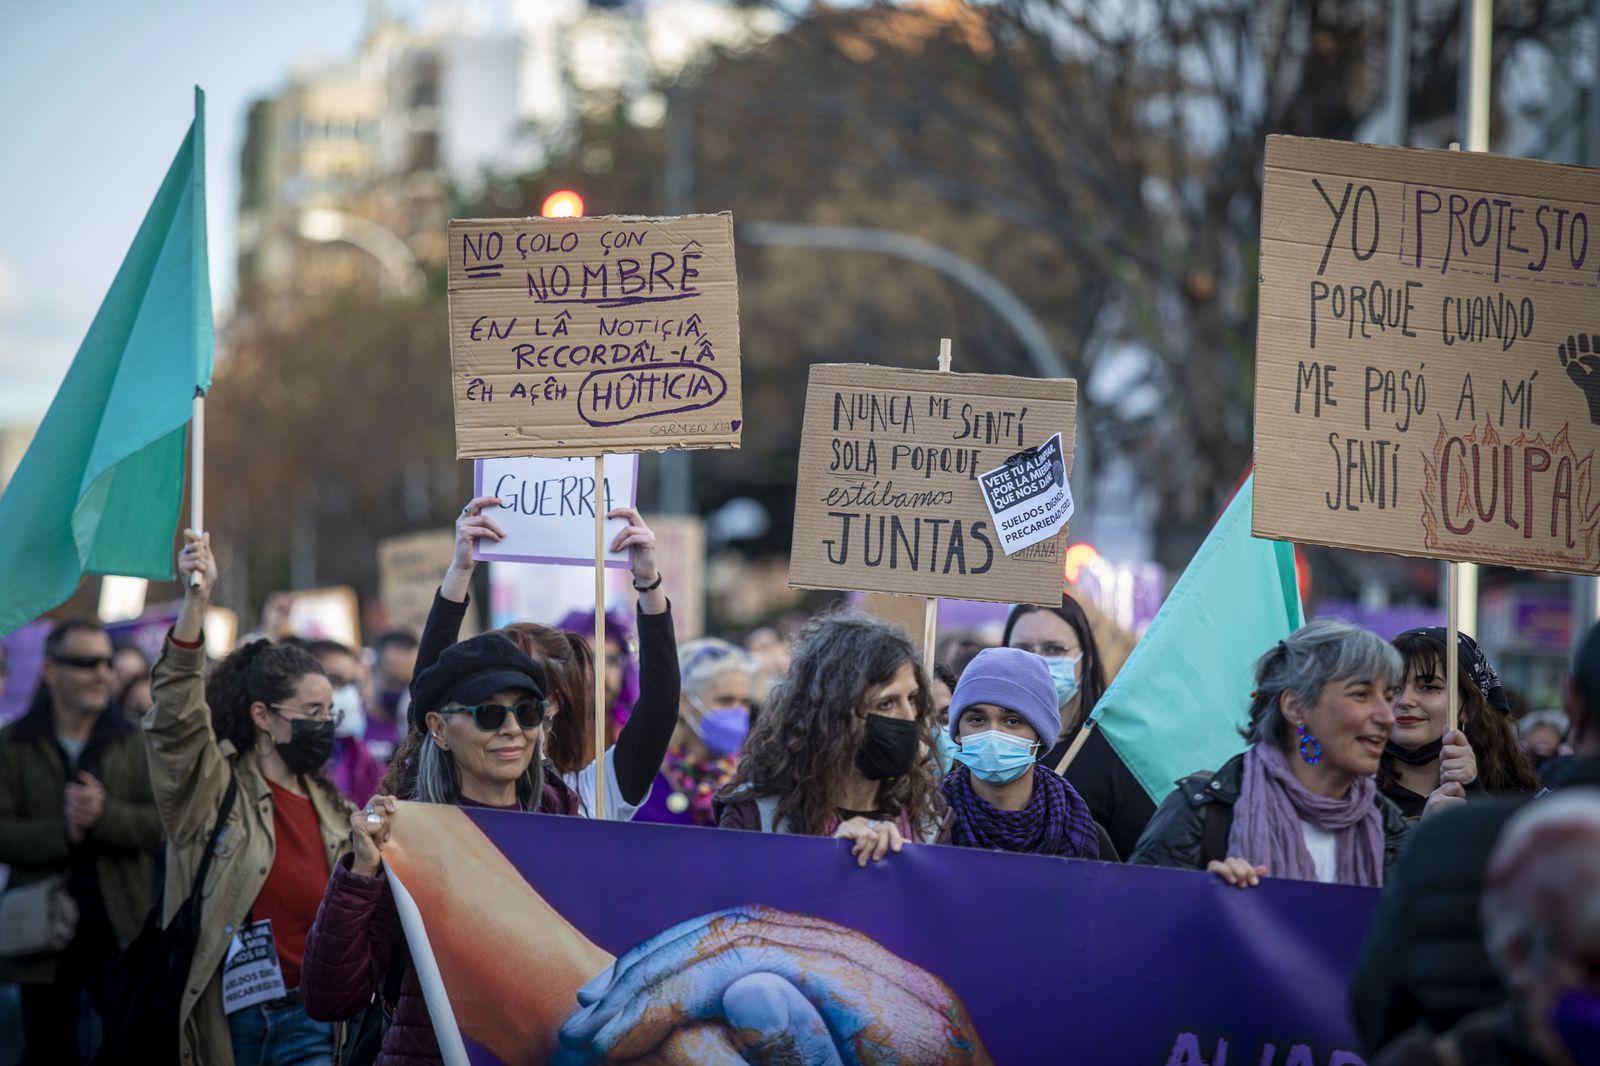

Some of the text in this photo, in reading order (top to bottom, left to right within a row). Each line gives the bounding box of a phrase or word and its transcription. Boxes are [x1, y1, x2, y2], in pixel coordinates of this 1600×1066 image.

[463, 230, 648, 266] NO ÇOLO ÇON
[1312, 178, 1589, 283] YO PROTESTO
[527, 240, 702, 300] NOMBRÊ
[470, 315, 517, 341] EN
[535, 309, 572, 338] LÂ
[1310, 280, 1535, 352] PORQUE CUANDO
[466, 377, 493, 402] ÊH
[1294, 361, 1539, 432] ME PASÓ A MÍ
[833, 393, 1028, 446] NUNCA ME SENTÍ
[830, 438, 981, 481] SOLA PORQUE
[985, 472, 1011, 488] VETE
[1010, 464, 1025, 480] TÚ
[1026, 461, 1036, 472] A
[495, 474, 614, 518] GUERRA
[821, 481, 953, 508] estábamos
[994, 494, 1016, 510] QUE
[1015, 484, 1038, 501] NOS
[1014, 475, 1030, 487] LA
[1325, 432, 1576, 549] SENTÍ CULPA
[1001, 505, 1045, 531] SUELDOS
[1005, 510, 1061, 543] PRECARIEDAD
[822, 512, 994, 575] JUNTAS
